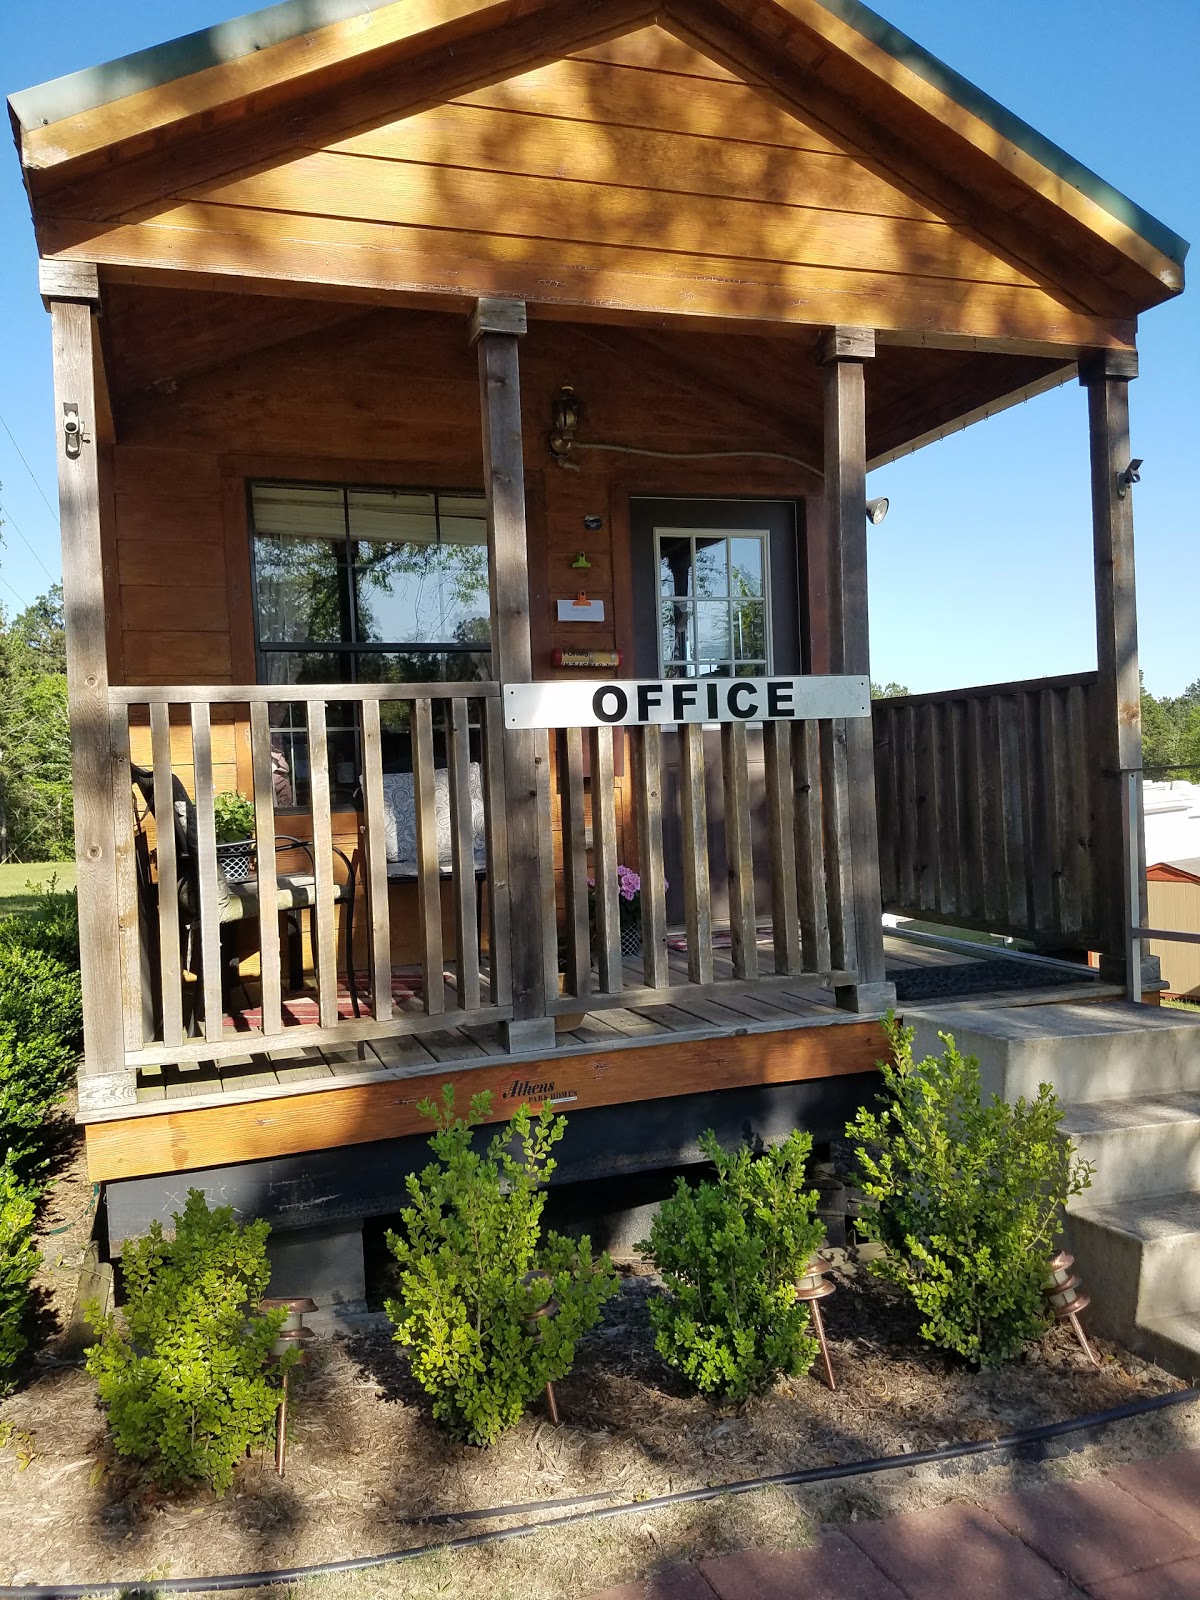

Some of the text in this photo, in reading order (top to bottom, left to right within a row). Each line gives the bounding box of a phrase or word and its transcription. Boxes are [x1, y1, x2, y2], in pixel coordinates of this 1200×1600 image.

[592, 682, 795, 723] OFFICE
[502, 1080, 555, 1099] Athens
[550, 1090, 578, 1100] HOMES
